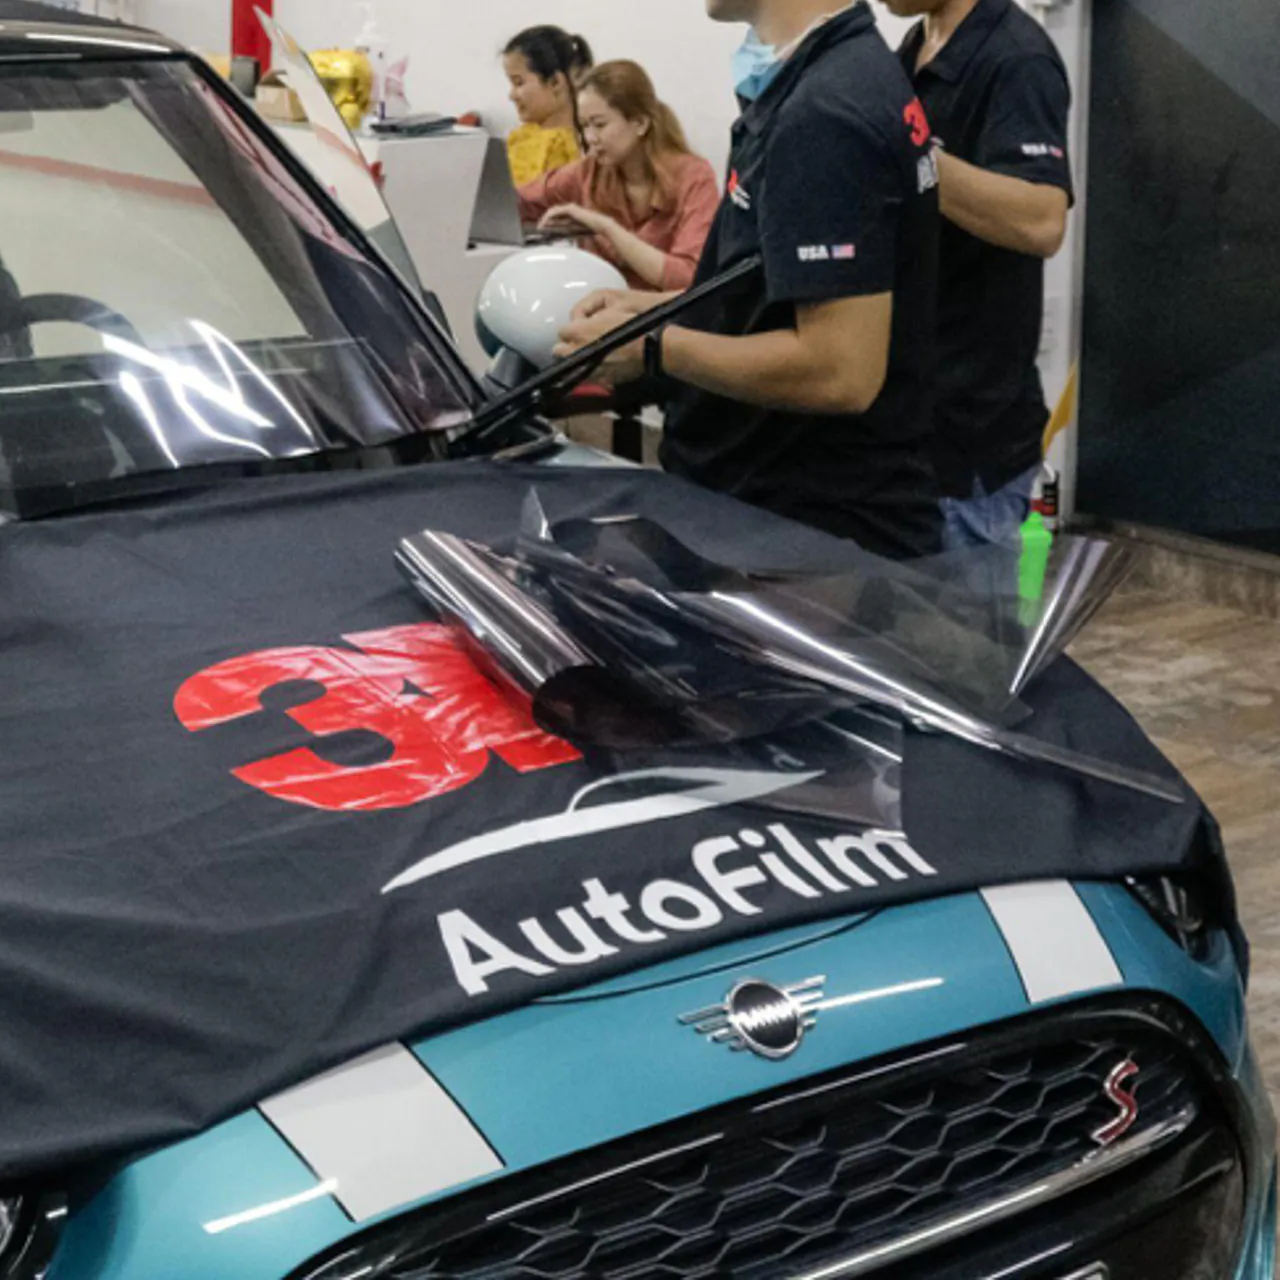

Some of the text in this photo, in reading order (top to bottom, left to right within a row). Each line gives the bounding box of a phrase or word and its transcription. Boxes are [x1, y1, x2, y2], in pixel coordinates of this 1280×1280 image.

[797, 245, 829, 261] USA
[436, 824, 938, 998] AutoFilm
[1091, 1058, 1140, 1147] S
